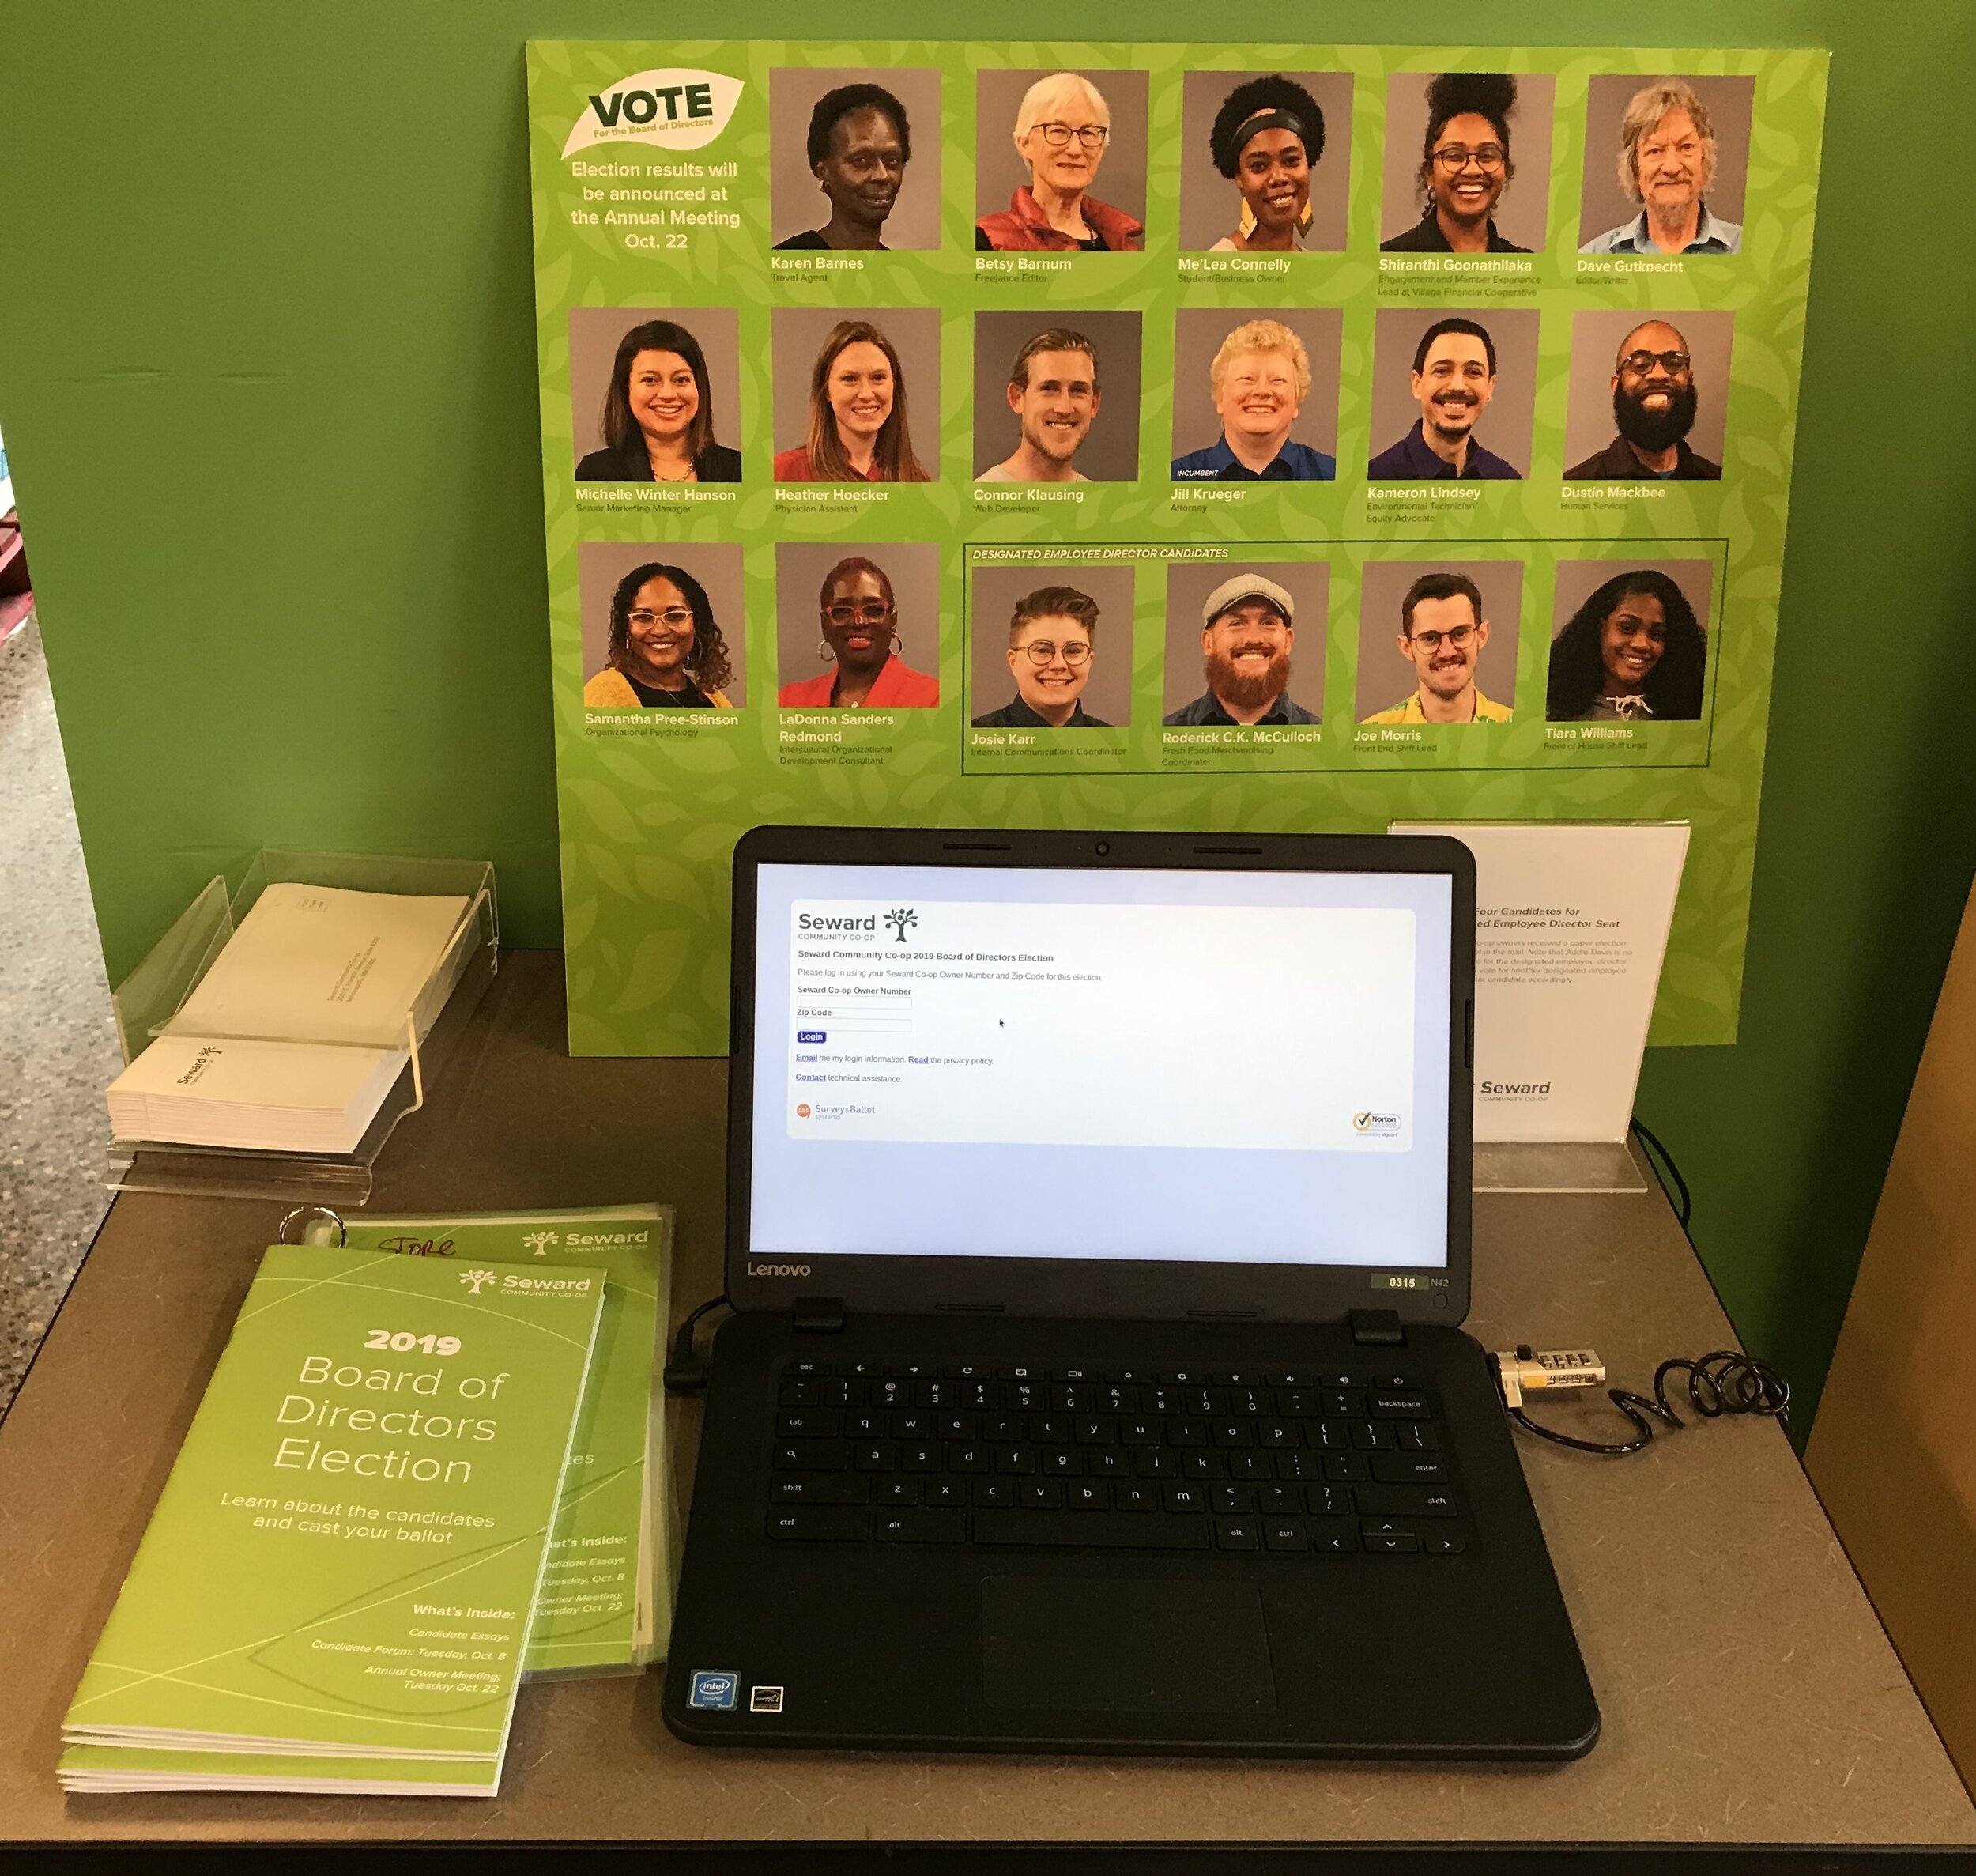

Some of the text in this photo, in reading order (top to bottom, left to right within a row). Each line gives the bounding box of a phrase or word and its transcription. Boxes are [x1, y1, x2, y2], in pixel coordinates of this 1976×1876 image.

[588, 83, 713, 127] VOTE
[629, 124, 656, 134] Board
[659, 122, 669, 130] of
[672, 119, 714, 129] Directors
[572, 161, 737, 176] Election results will
[583, 186, 727, 201] be announced at
[571, 210, 740, 228] the Annual Meeting
[625, 234, 687, 248] Oct. 22
[772, 257, 864, 270] Karen Barnes
[975, 258, 1071, 272] Betsy Barnum
[1178, 258, 1291, 272] Me'Lea Connelly
[1379, 259, 1532, 272] Shiranthi Goonathilaka
[1578, 261, 1683, 273] Dave Gutknecht
[772, 274, 828, 283] Travel Agent
[975, 274, 1047, 283] Freelance Editor
[1178, 274, 1286, 284] Student/Business Owner
[575, 489, 735, 501] Michelle Winter Hanson
[775, 489, 888, 501] Heather Hoecker
[974, 489, 1084, 504] Connor Klausing
[1171, 489, 1246, 502] Jill Krueger
[1367, 487, 1480, 500] Kameron Lindsey
[1562, 487, 1665, 498] Dustin Mackbee
[607, 504, 650, 513] Marketing
[653, 504, 692, 514] Manager
[775, 504, 816, 513] Physician
[974, 504, 1039, 515] Web Developer
[1171, 504, 1207, 514] Attorney
[973, 549, 1228, 559] DESIGNATED EMPLOYEE DIRECTOR CANDIDATES
[585, 713, 738, 725] Samantha Pree-Stinson
[779, 713, 894, 725] LaDonna Sanders
[586, 727, 698, 739] Organizational Psychology
[780, 731, 841, 742] Redmond
[1163, 731, 1320, 744] Roderick C.K. McCulloch
[1354, 730, 1421, 742] Joe Morris
[1545, 727, 1633, 739] Tiara Williams
[971, 734, 1035, 745] Josie Karr
[798, 913, 876, 930] Seward
[1494, 920, 1546, 929] Employee
[798, 950, 830, 959] Seward
[833, 951, 882, 961] Community
[885, 952, 911, 961] Co-op
[976, 953, 1016, 961] Directors
[1018, 953, 1054, 962] Election
[828, 987, 851, 996] Co-op
[797, 1009, 809, 1017] Zip
[800, 1032, 823, 1042] Login
[845, 1055, 862, 1064] login
[865, 1055, 906, 1063] information.
[944, 1057, 969, 1066] privacy
[971, 1057, 994, 1066] policy.
[177, 1058, 206, 1085] Seward
[1480, 1081, 1551, 1093] Seward
[566, 1230, 648, 1246] Seward
[748, 1262, 811, 1276] Lenovo
[503, 1275, 590, 1291] Seward
[1390, 1278, 1415, 1288] 0315
[500, 1289, 554, 1298] COMMUNITY
[364, 1329, 461, 1356] 2019
[299, 1356, 511, 1399] Board of
[1378, 1400, 1420, 1409] backspace
[277, 1395, 497, 1441] Directors
[274, 1438, 472, 1483] Election
[221, 1493, 496, 1528] Learn about the candidates
[253, 1515, 452, 1544] and cast your ballot
[466, 1607, 515, 1619] Inside:
[409, 1628, 509, 1642] Candidate Essays
[311, 1640, 371, 1653] Candidate
[375, 1646, 413, 1656] Forum:
[418, 1648, 467, 1660] Tuesday,
[472, 1651, 493, 1660] Oct.
